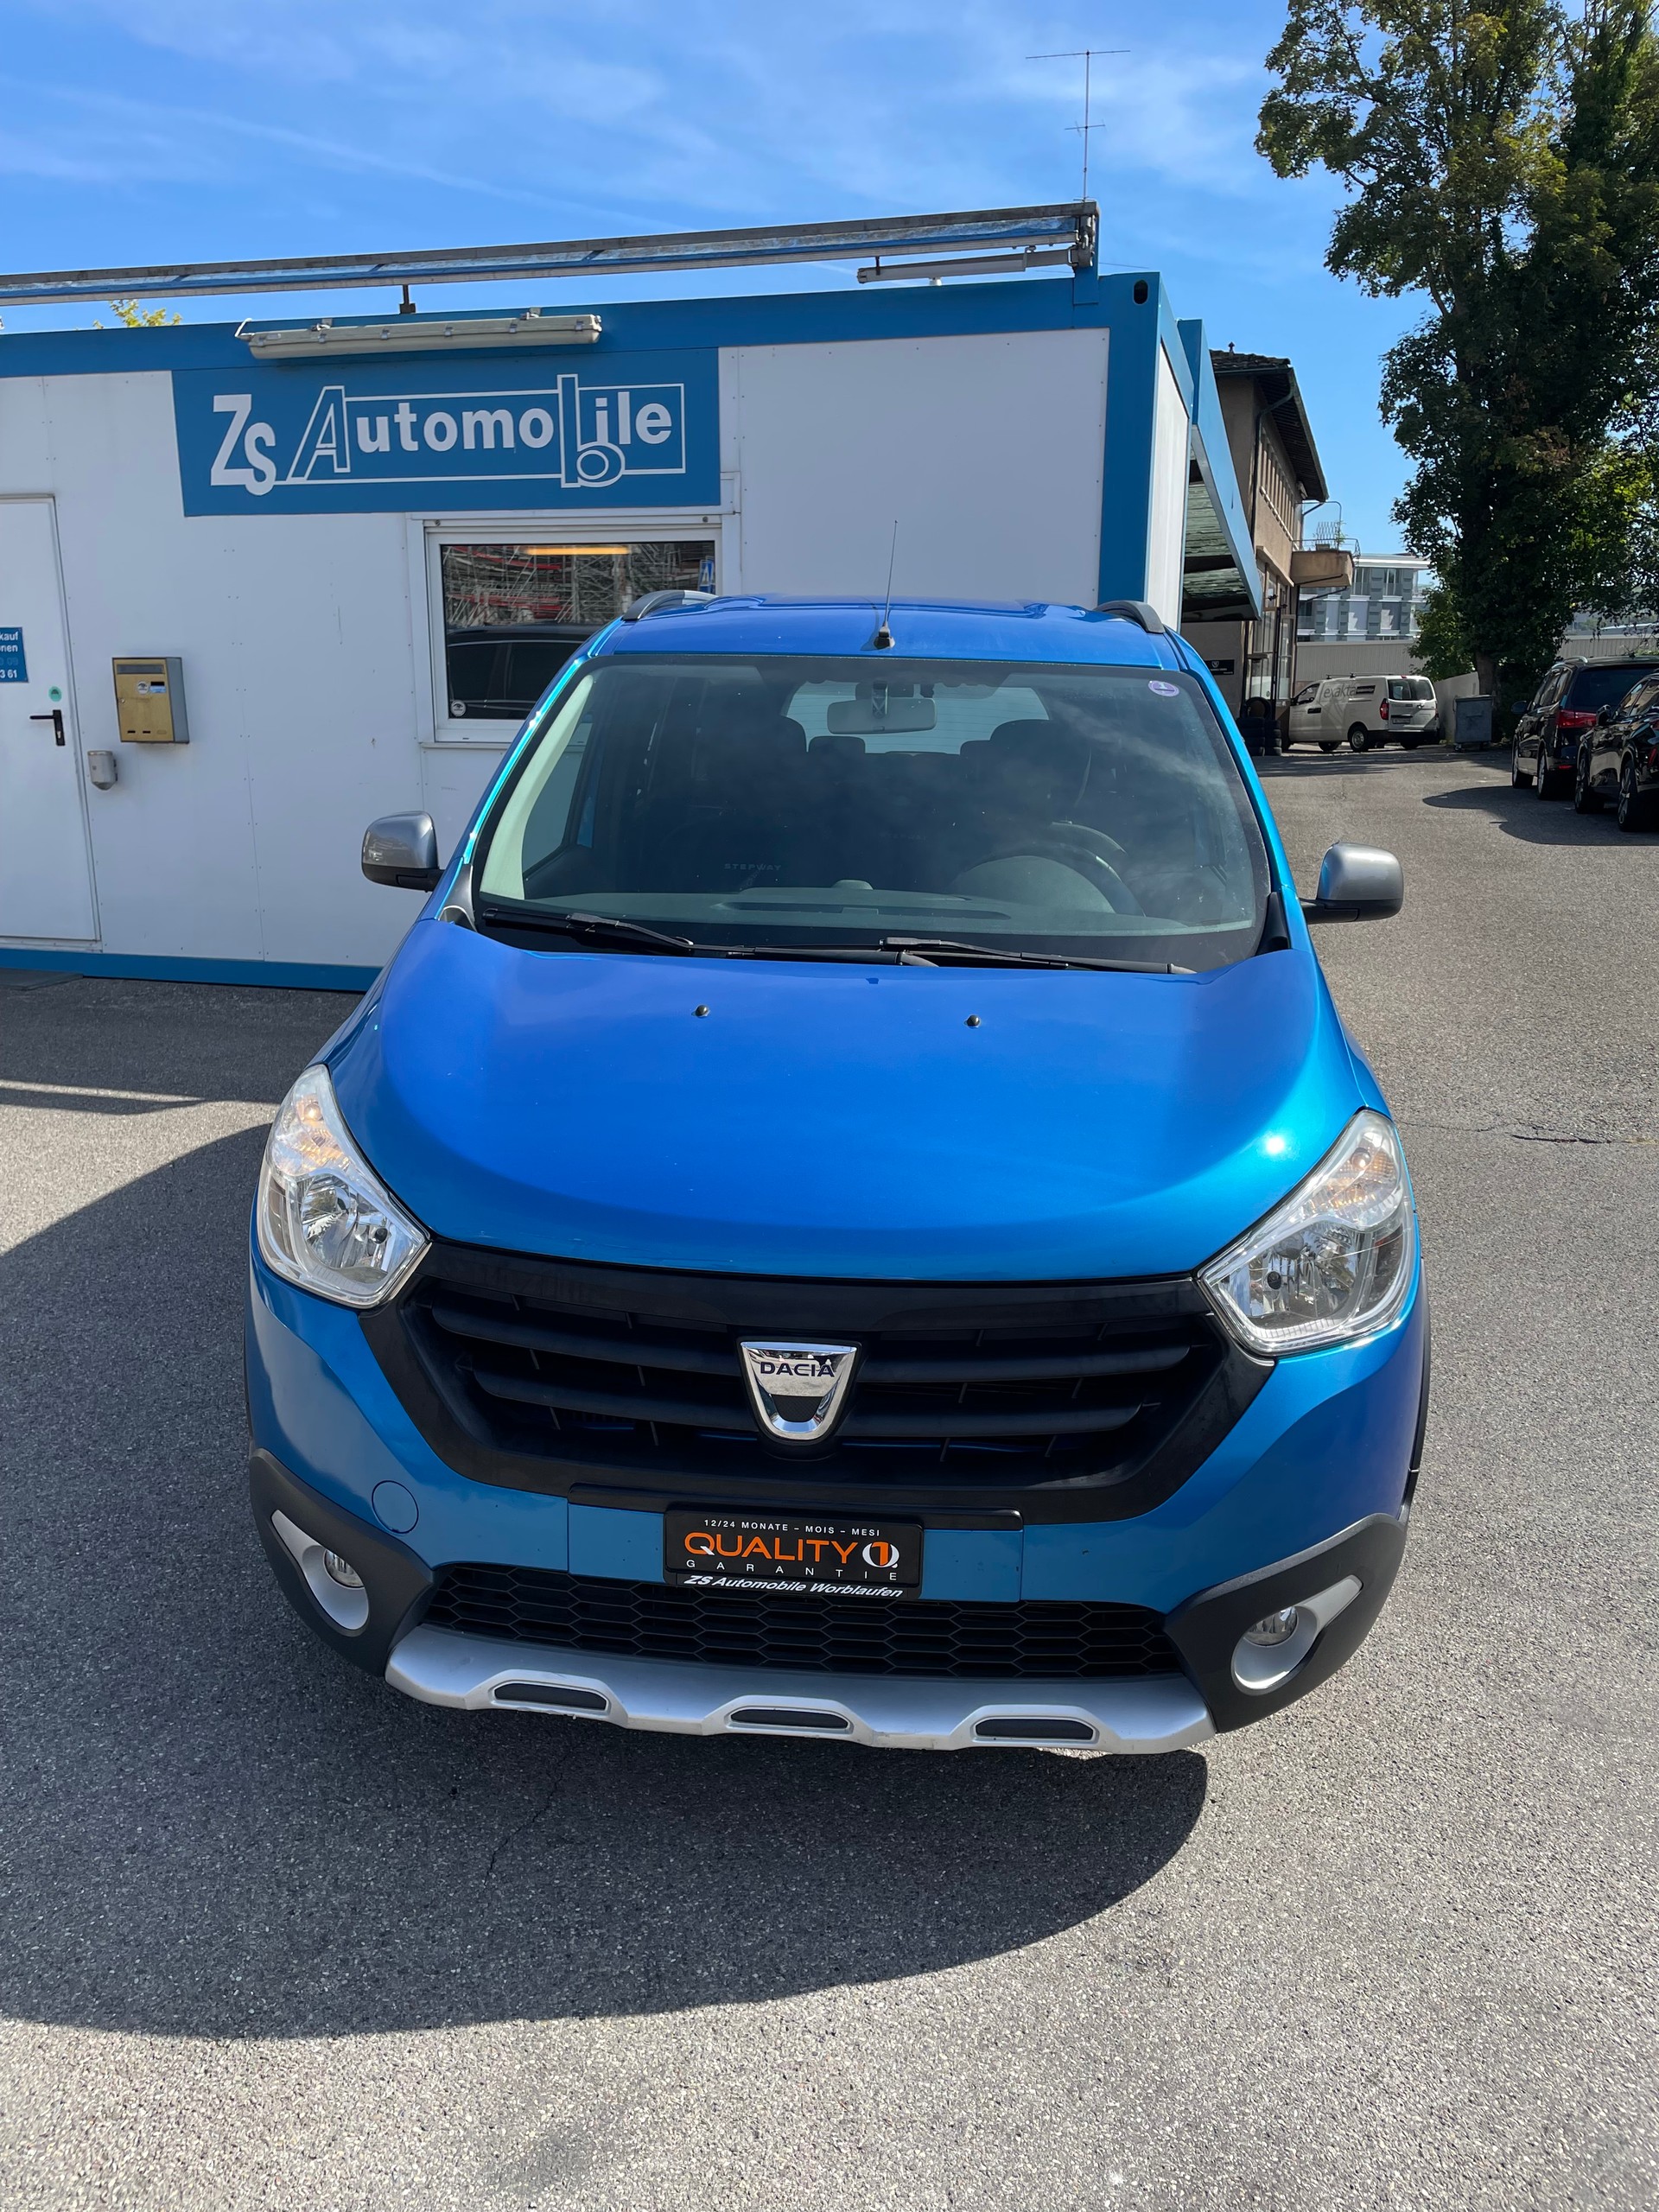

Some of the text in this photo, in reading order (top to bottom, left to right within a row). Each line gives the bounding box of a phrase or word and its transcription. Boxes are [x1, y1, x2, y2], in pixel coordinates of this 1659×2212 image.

[286, 374, 672, 488] Automobile
[0, 644, 18, 652] nen
[7, 669, 17, 678] 61
[1324, 684, 1357, 698] exakta
[760, 1361, 835, 1378] DACIA
[703, 1519, 736, 1529] 12/24
[741, 1521, 789, 1531] MONATE
[804, 1524, 836, 1535] MOIS
[851, 1528, 880, 1537] MESI
[684, 1532, 858, 1564] QUALITY
[686, 1559, 897, 1581] GARANTIE
[684, 1574, 904, 1598] ZS Automobile Worblaufen
